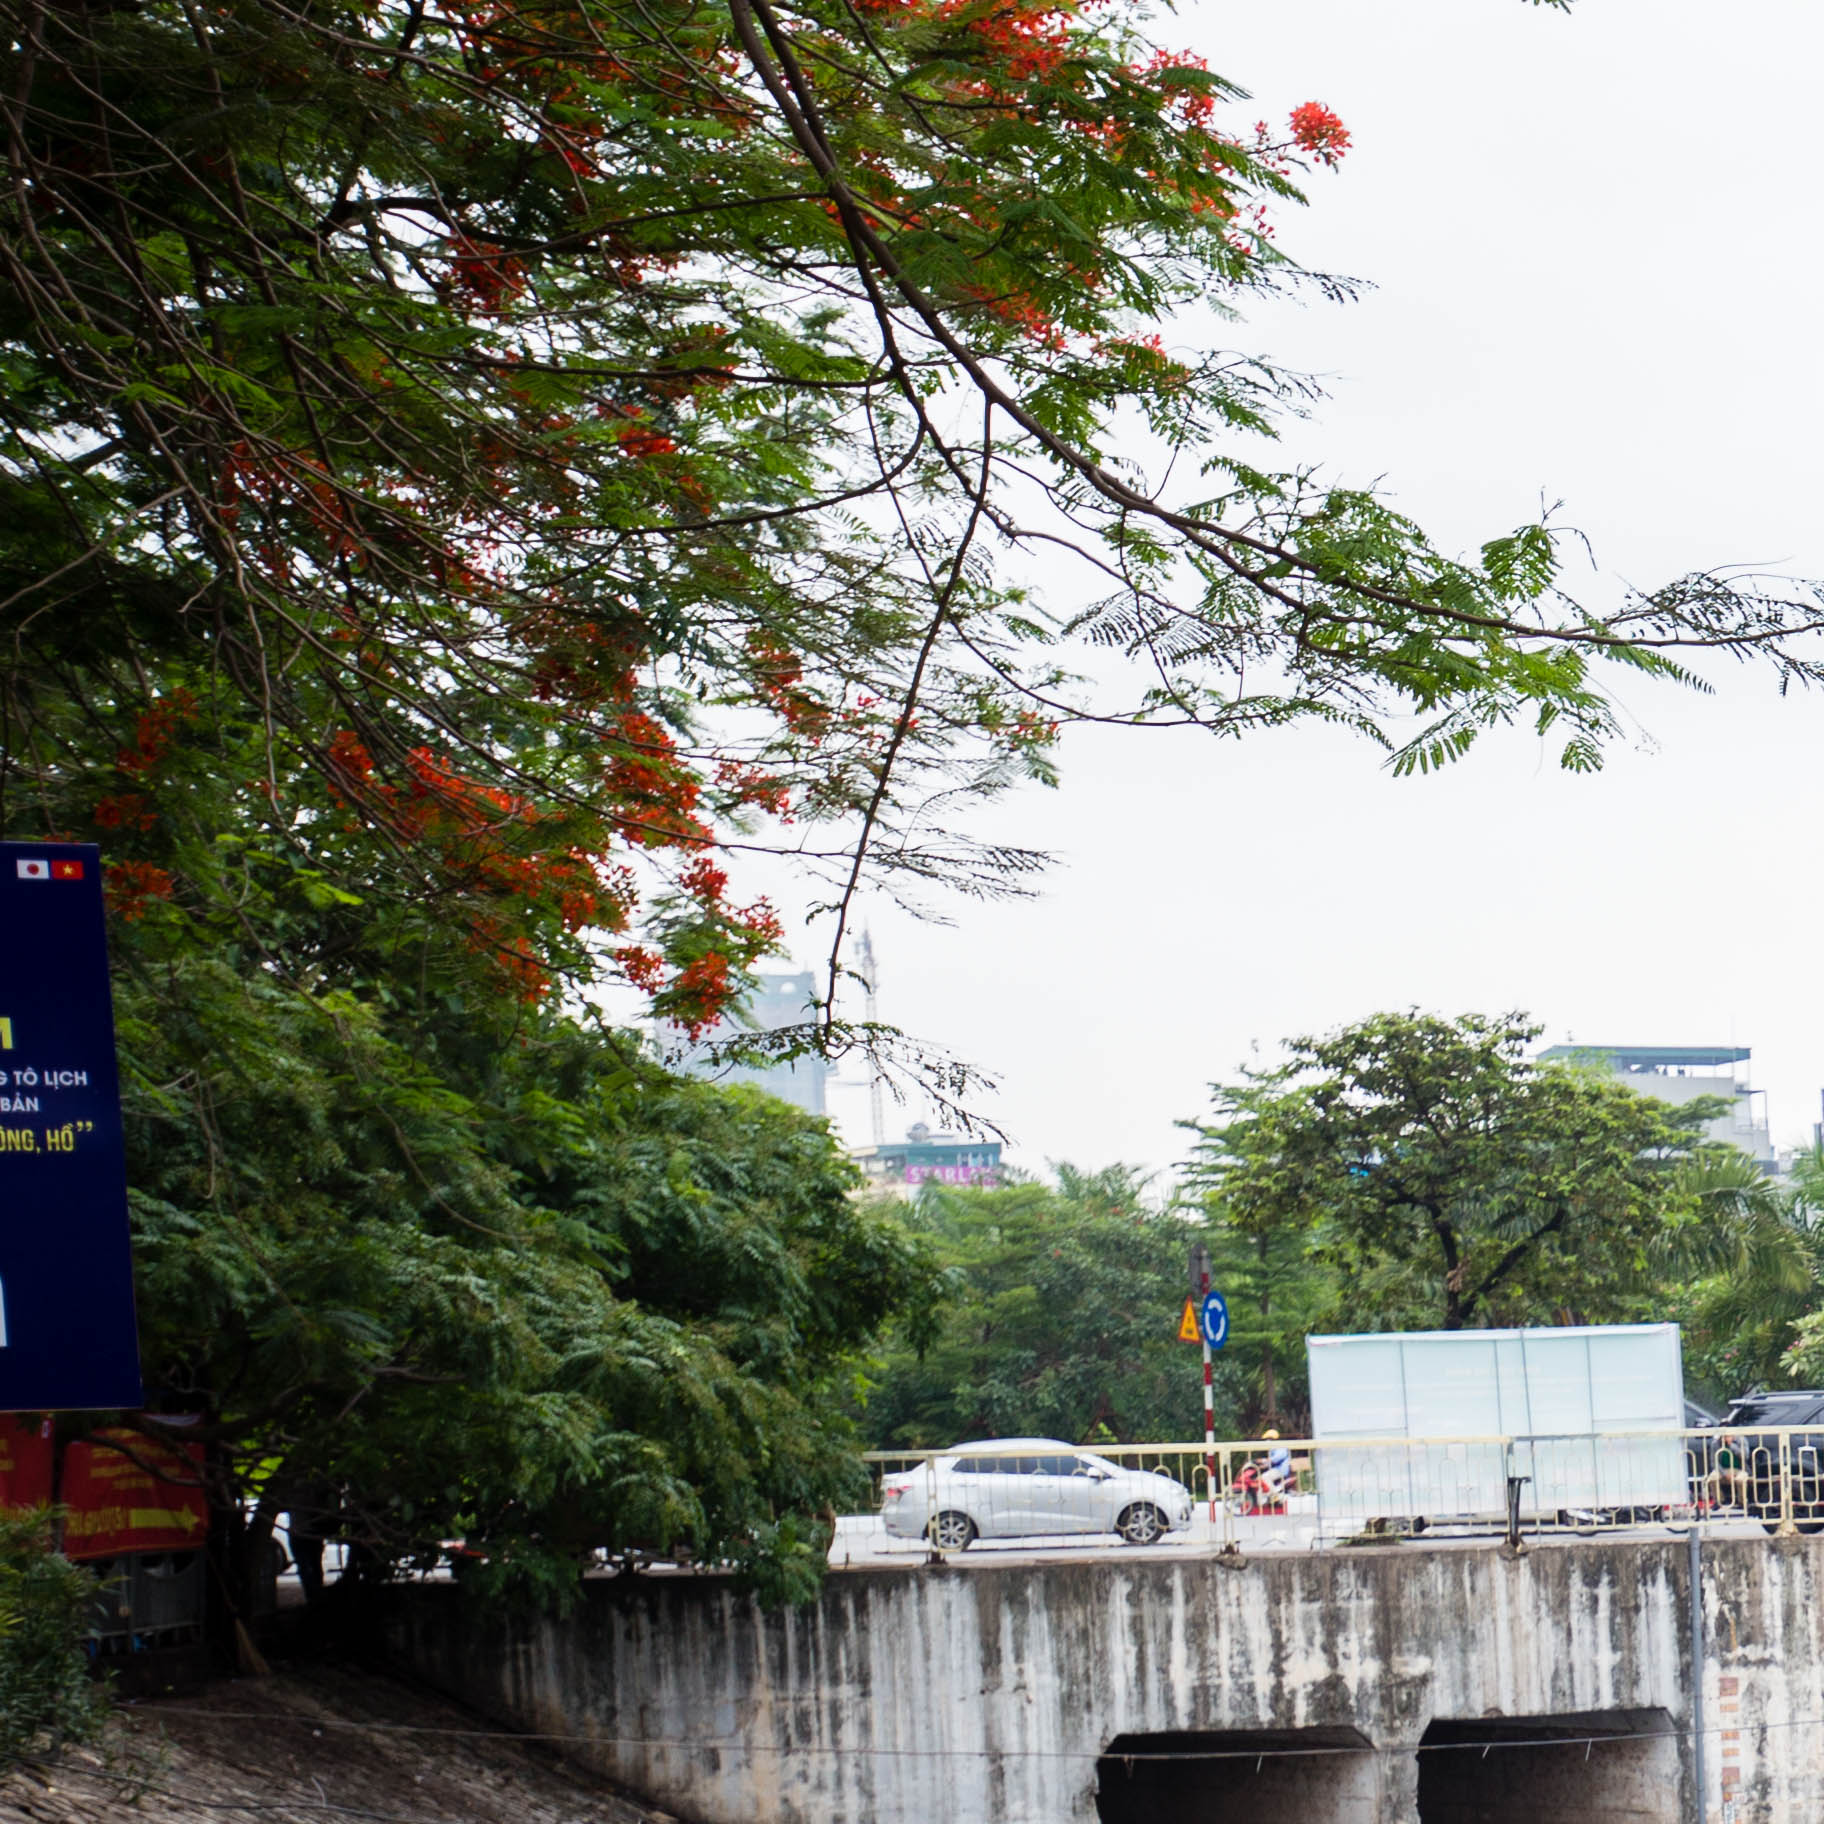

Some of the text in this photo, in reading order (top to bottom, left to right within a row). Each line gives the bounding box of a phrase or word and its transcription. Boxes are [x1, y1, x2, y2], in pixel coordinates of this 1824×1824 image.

[13, 1067, 39, 1086] TÔ
[44, 1070, 89, 1091] LỊCH
[0, 1092, 40, 1112] BẢN
